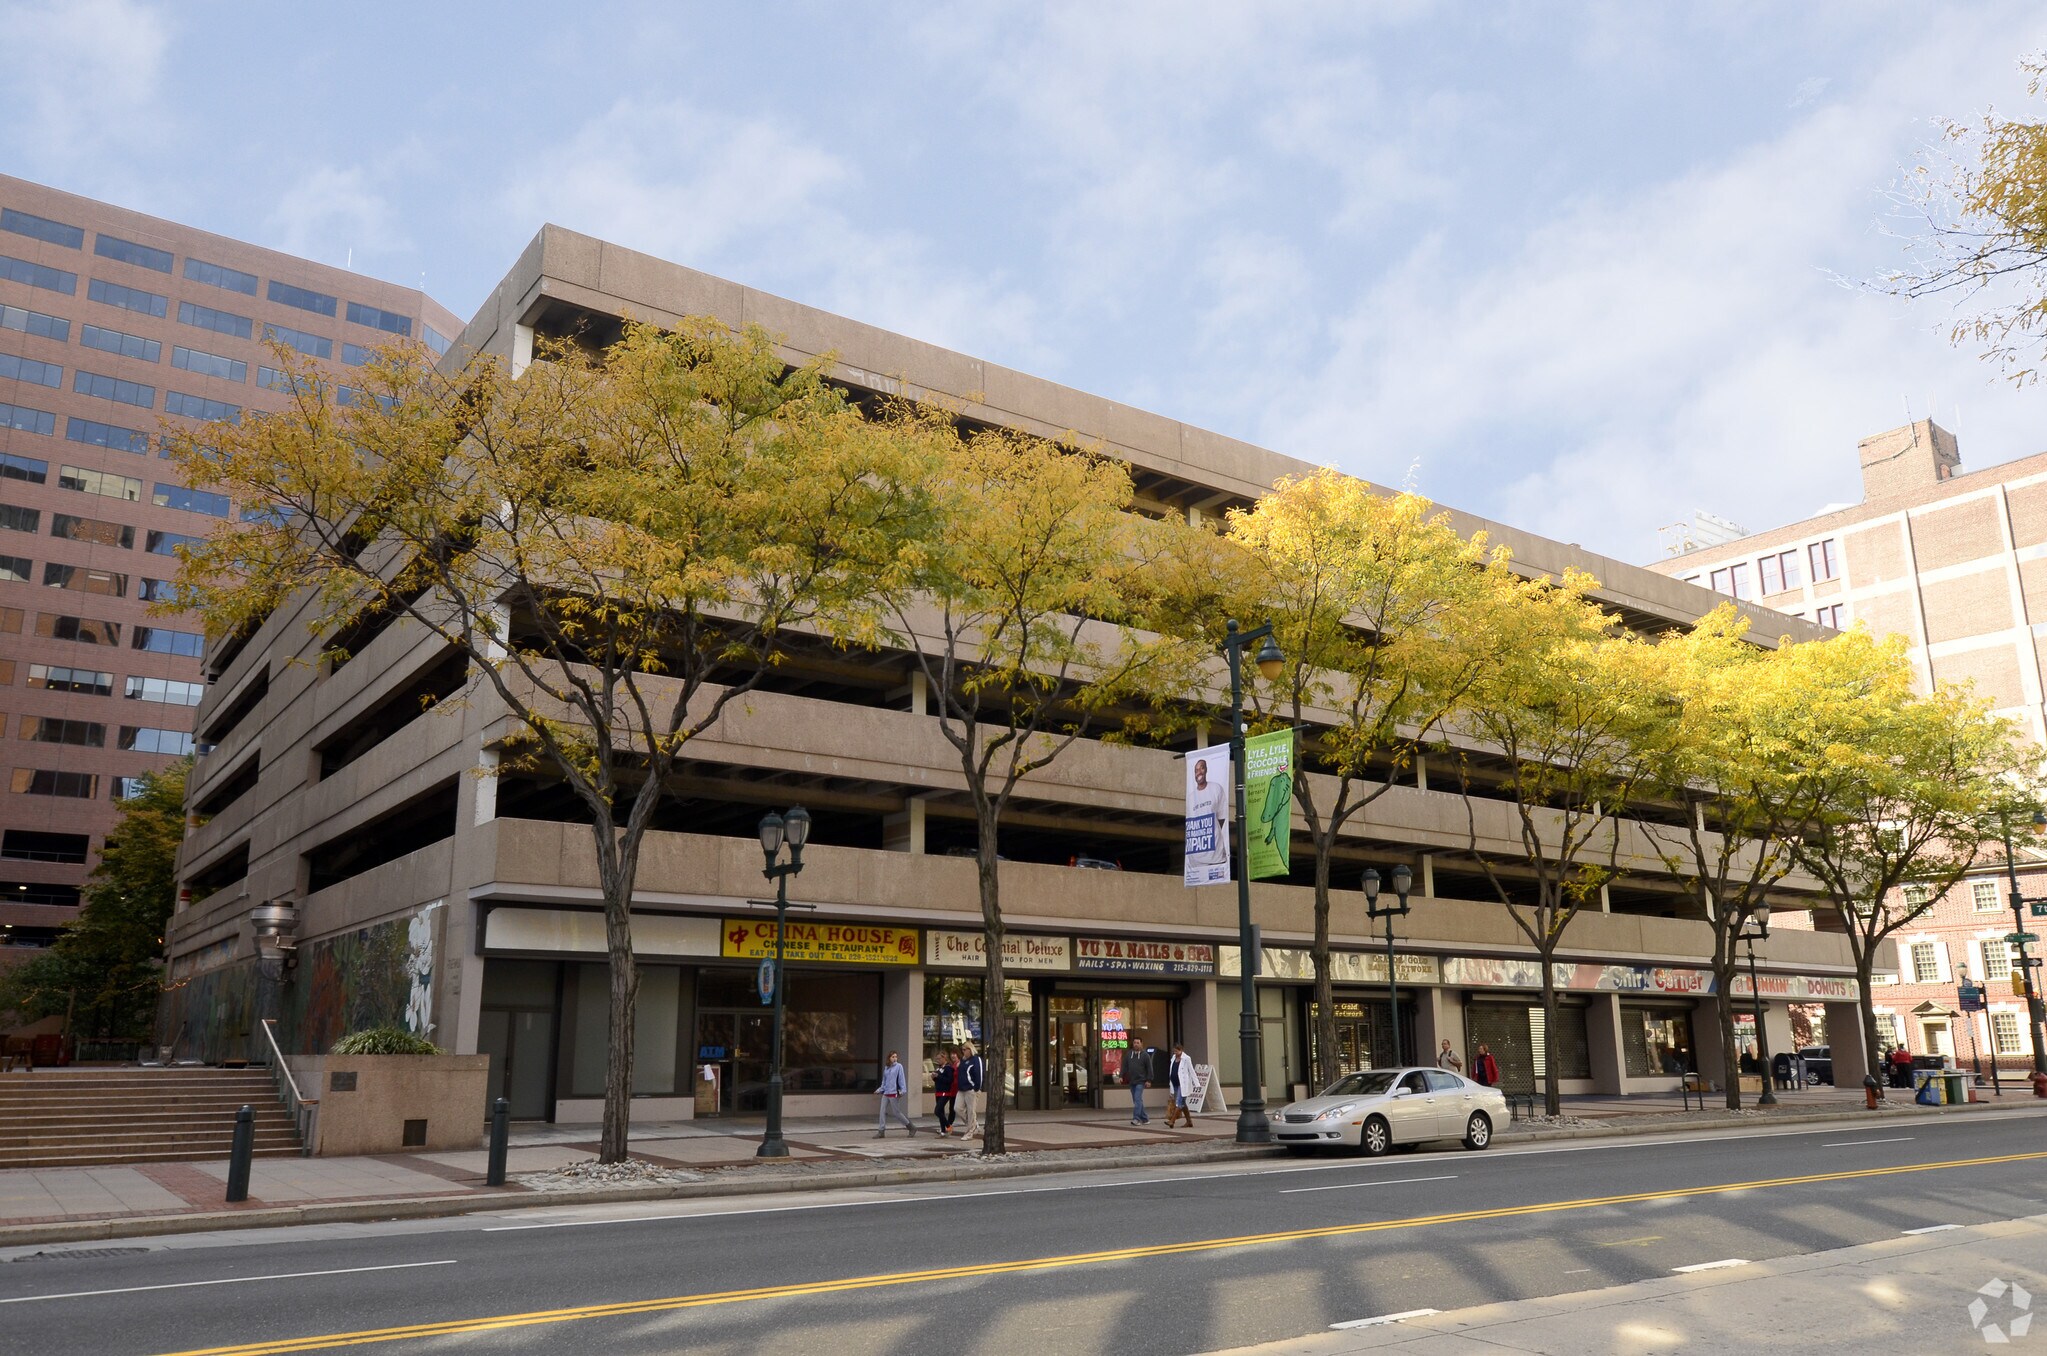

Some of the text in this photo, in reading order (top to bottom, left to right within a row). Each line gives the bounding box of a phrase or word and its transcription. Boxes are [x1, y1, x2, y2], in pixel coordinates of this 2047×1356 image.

[1201, 816, 1213, 828] YOU
[728, 925, 749, 953] 中
[755, 923, 895, 944] CHINA HOUSE
[763, 940, 885, 954] CHNESE RESTAURANT
[947, 935, 1063, 956] The Conial Deluxe
[1079, 940, 1213, 962] YU YA NAILS & SPA
[750, 949, 765, 957] EAT
[786, 951, 805, 959] TAKE
[1078, 959, 1105, 968] NAILS
[1110, 961, 1127, 970] SPA
[1132, 961, 1165, 971] WAXING
[1612, 968, 1703, 990] Shirt Corner
[1807, 980, 1846, 996] DONUTS
[700, 1046, 725, 1058] ATM
